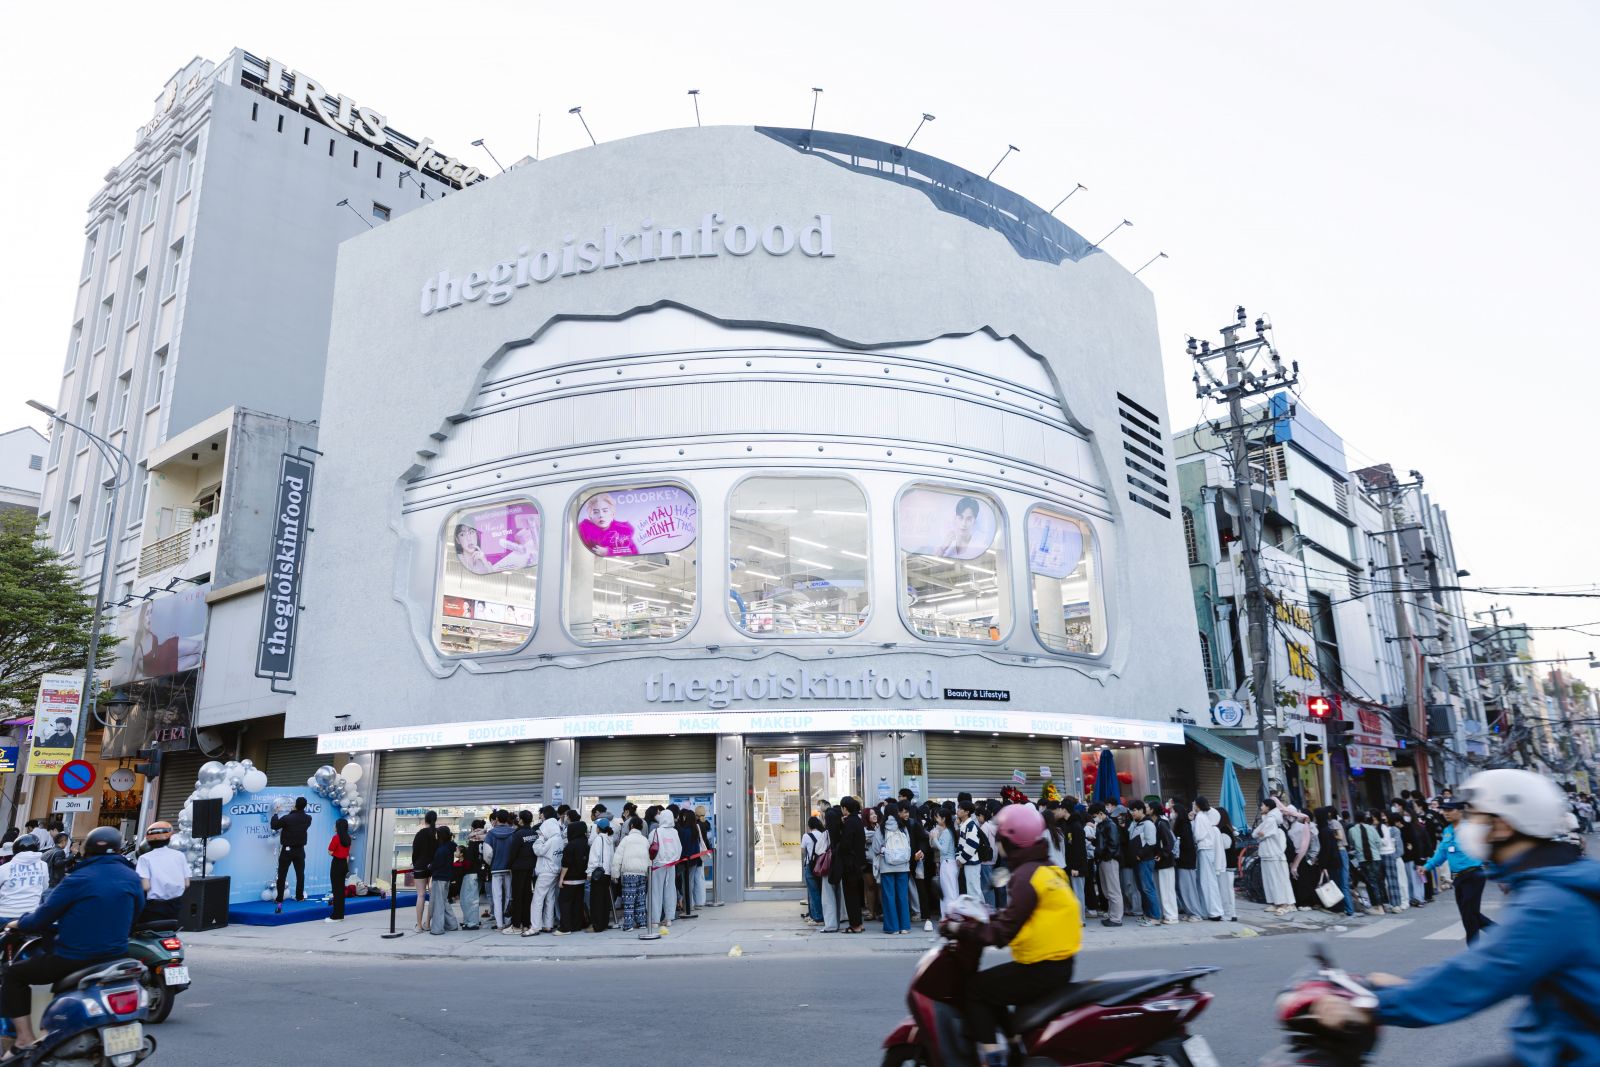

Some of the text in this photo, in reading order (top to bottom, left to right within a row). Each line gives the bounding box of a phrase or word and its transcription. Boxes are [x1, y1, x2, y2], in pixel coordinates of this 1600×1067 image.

[263, 56, 481, 189] IRIS Hotel
[419, 213, 836, 316] thegioiskinfood
[617, 489, 679, 505] COLORKEY
[267, 475, 304, 656] thegioiskinfood
[645, 669, 940, 708] thegioiskinfood
[947, 689, 971, 700] Beauty
[979, 690, 1008, 701] Lifestyle
[154, 726, 186, 741] VERA
[322, 737, 368, 750] SKINCARE
[392, 732, 443, 746] LIFESTYLE
[468, 725, 526, 740] BODYCARE
[563, 720, 633, 733] HAIRCARE
[679, 718, 720, 730] MASK
[750, 716, 813, 729] MAKEUP
[851, 714, 923, 727] SKINCARE
[954, 716, 1008, 729] LIFESTYLE
[1031, 719, 1073, 732] BODYCARE
[230, 803, 270, 815] GRAND
[246, 826, 261, 834] THE
